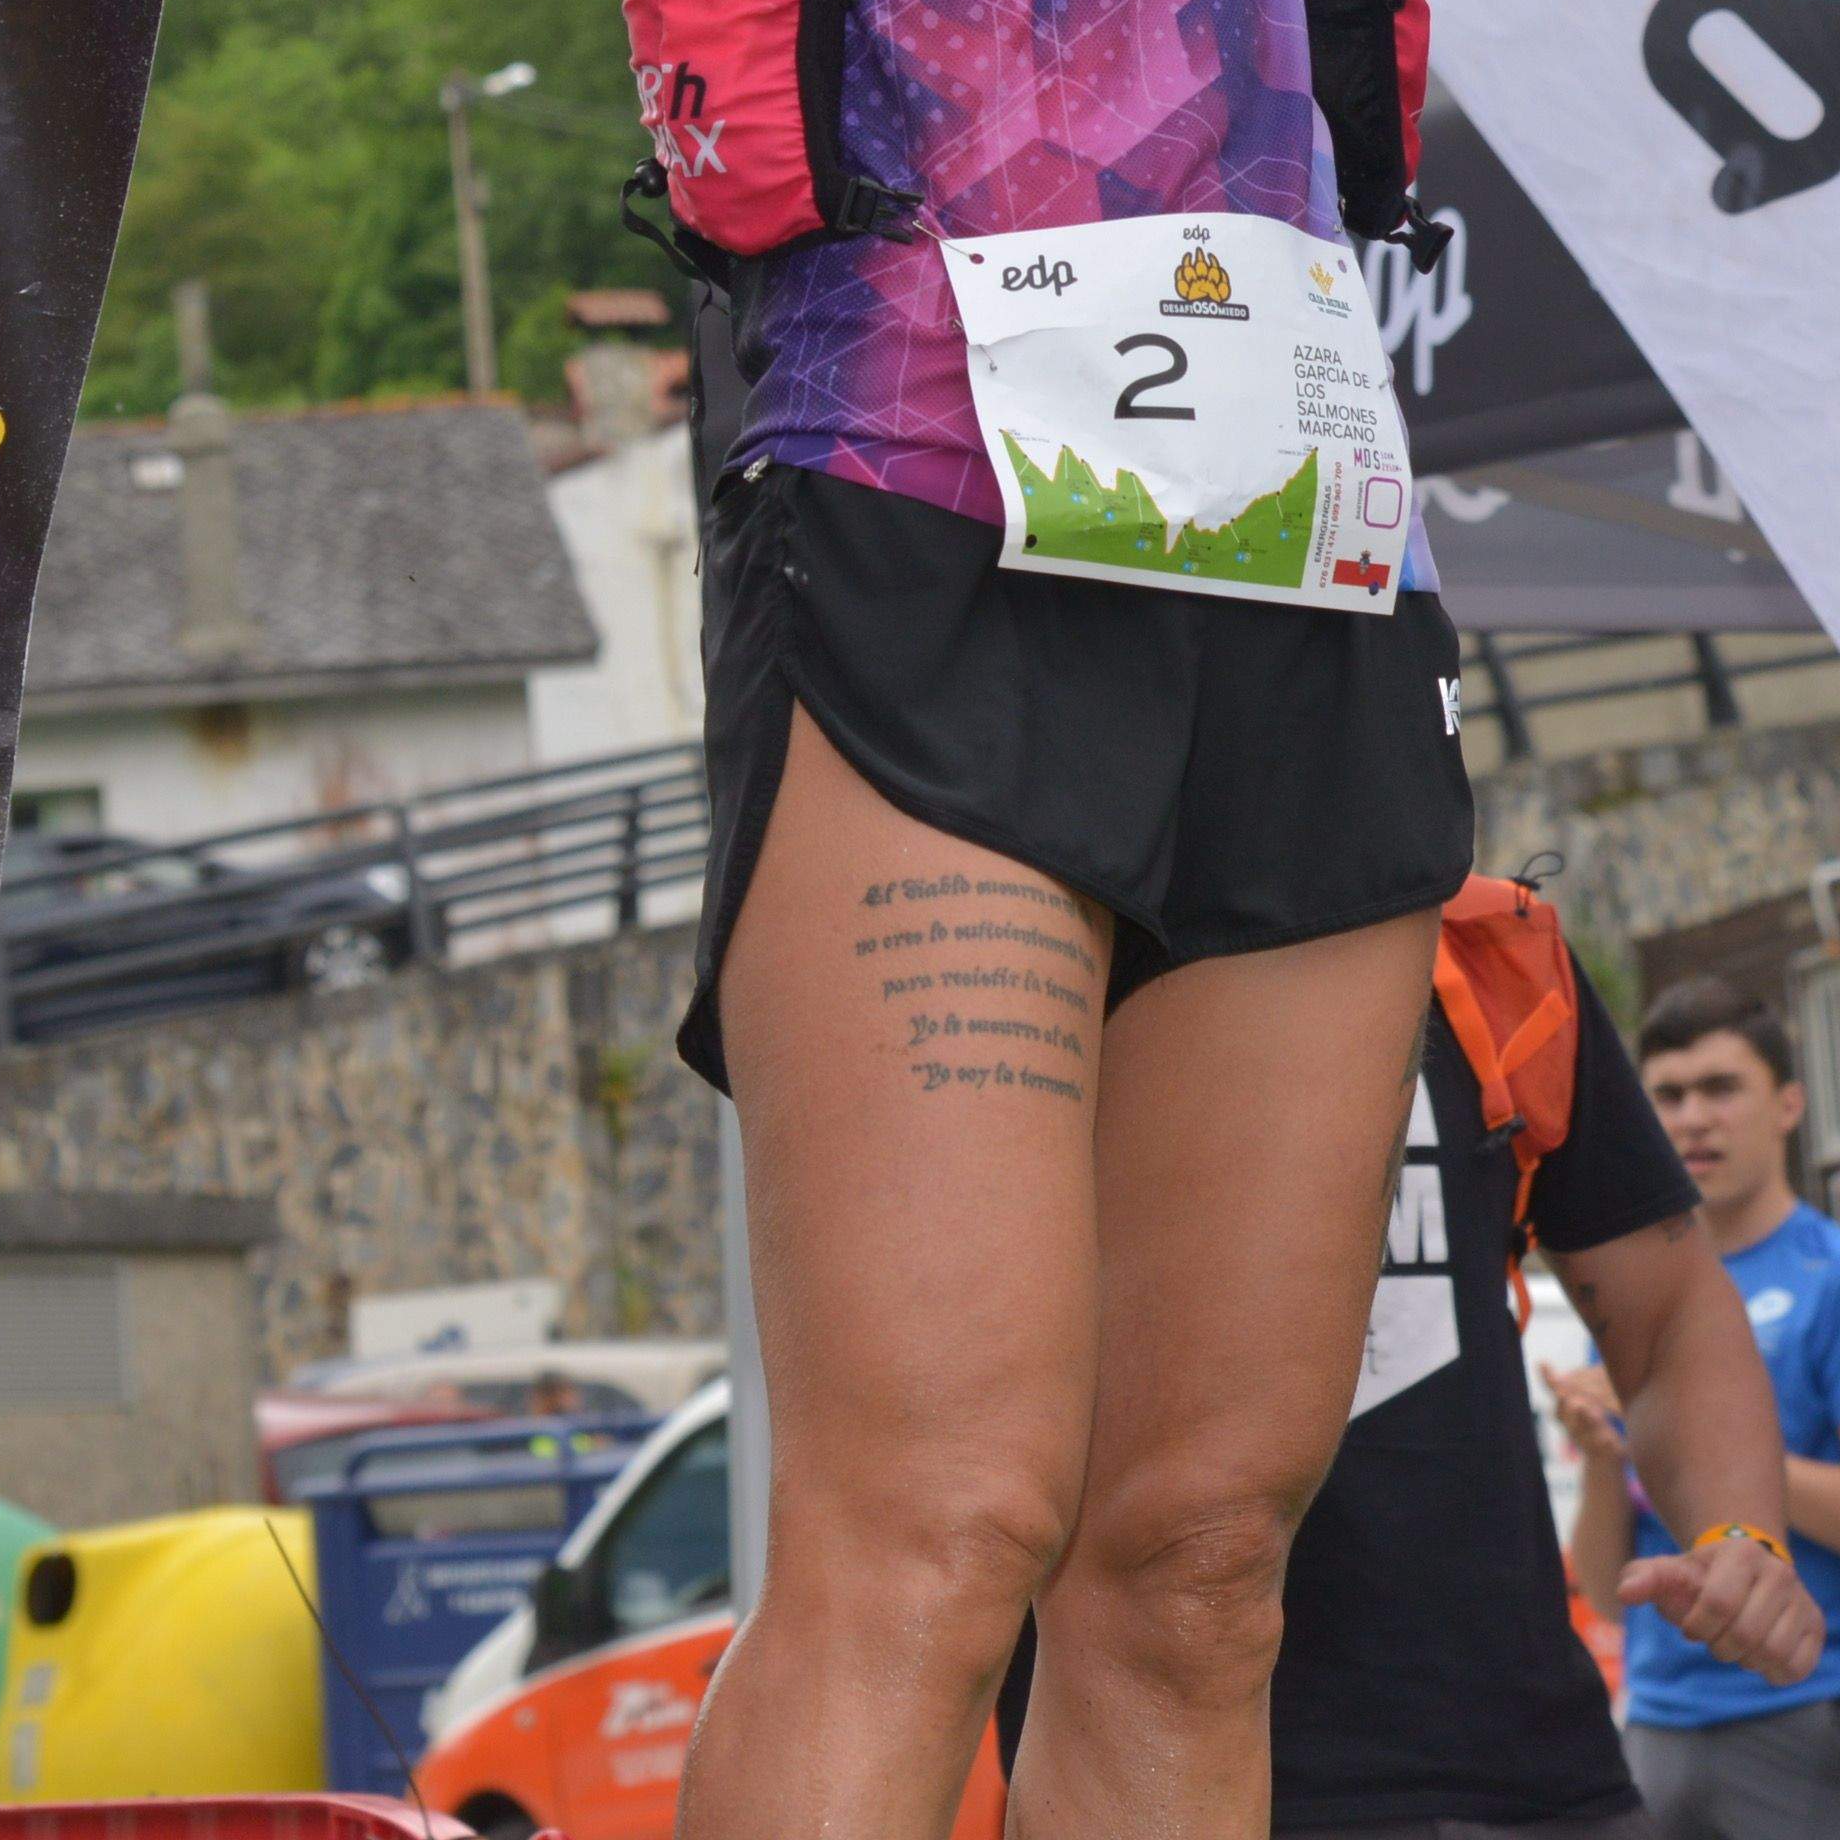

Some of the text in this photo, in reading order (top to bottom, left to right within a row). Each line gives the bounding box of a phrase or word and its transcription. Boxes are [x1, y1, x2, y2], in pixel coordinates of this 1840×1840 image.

[1182, 224, 1211, 244] edp
[1001, 254, 1078, 296] edp
[1293, 344, 1343, 366] AZARA
[1113, 332, 1196, 421] 2
[1294, 363, 1371, 390] GARCIA DE
[1295, 381, 1326, 400] LOS
[1297, 400, 1378, 426] SALMONES
[1298, 418, 1376, 444] MARCANO
[1314, 485, 1333, 564] EMERGENCIAS
